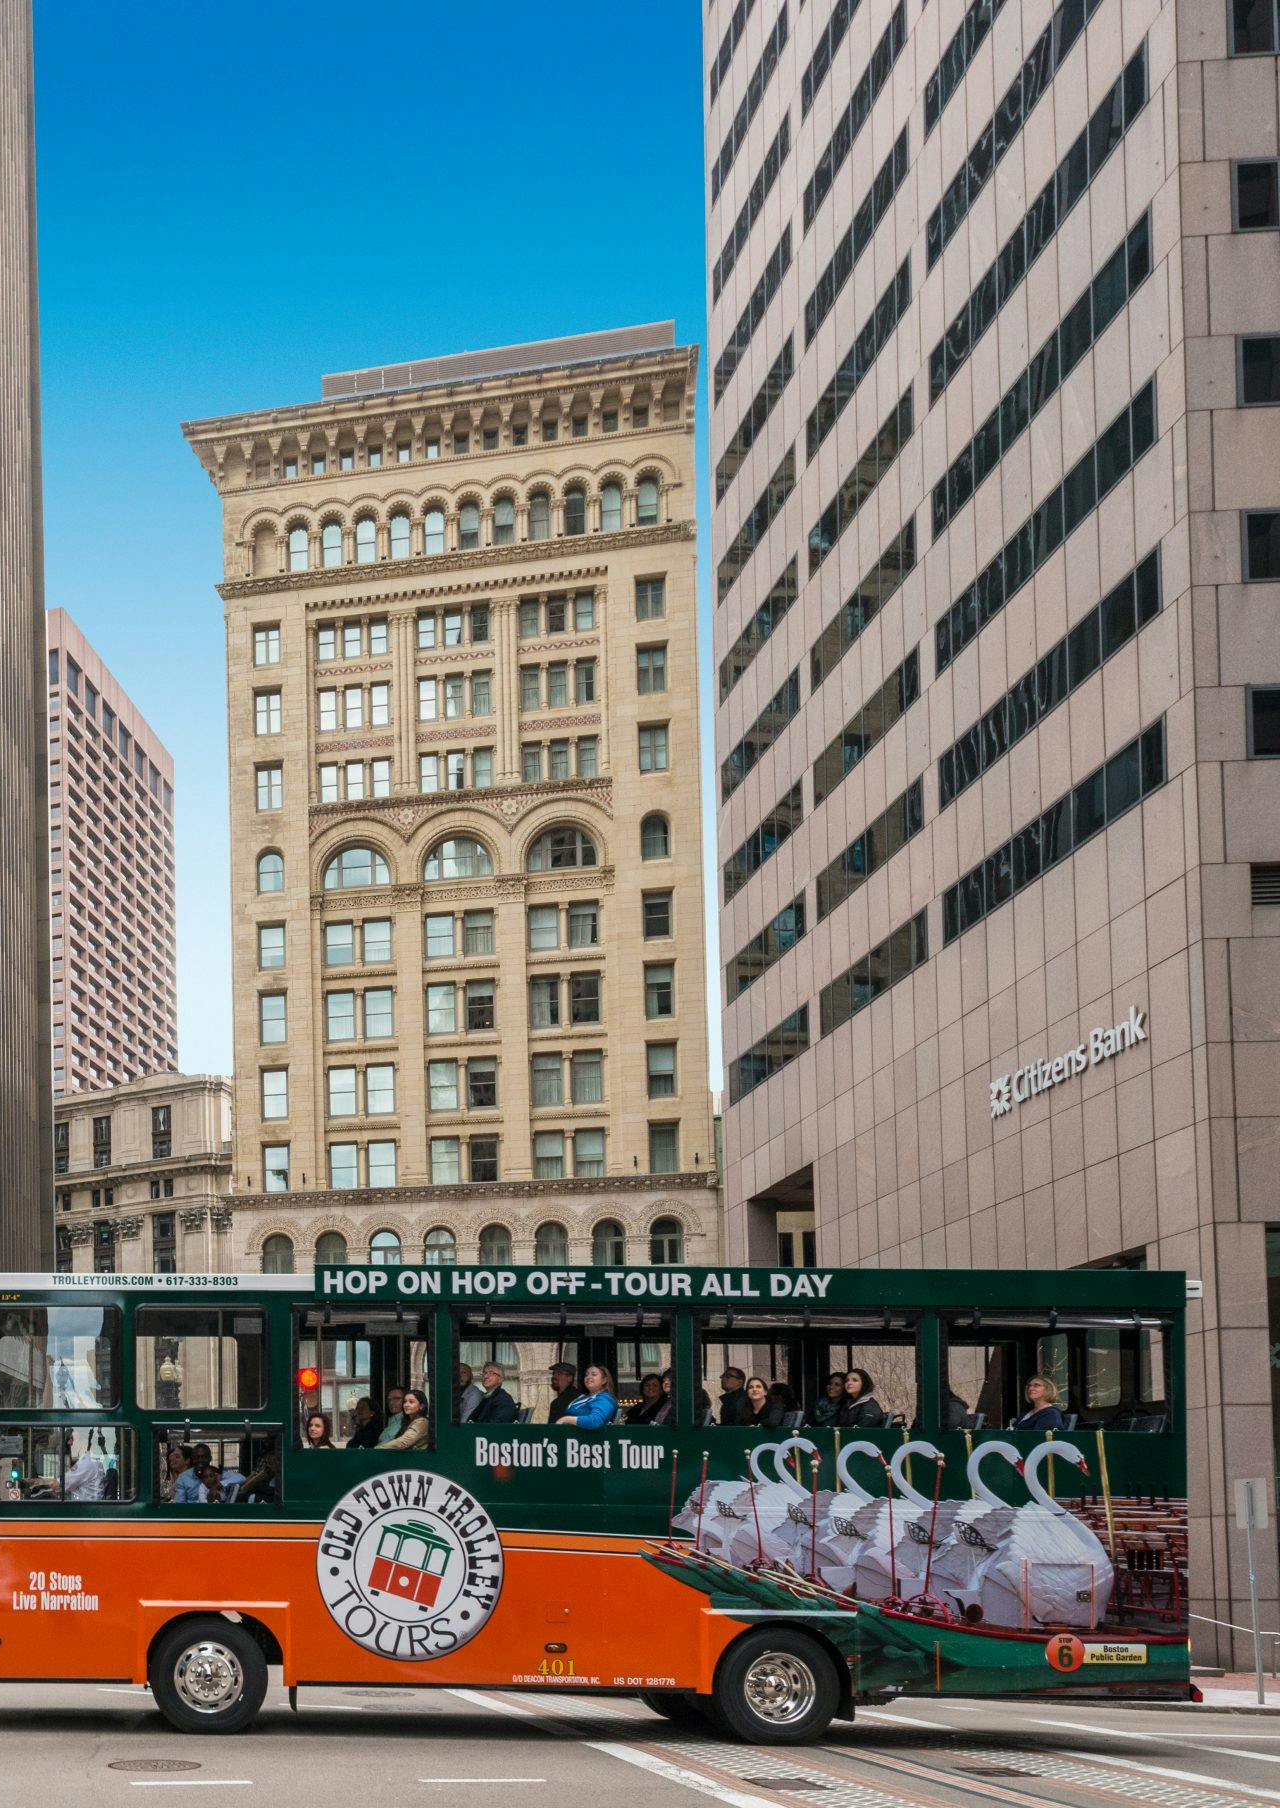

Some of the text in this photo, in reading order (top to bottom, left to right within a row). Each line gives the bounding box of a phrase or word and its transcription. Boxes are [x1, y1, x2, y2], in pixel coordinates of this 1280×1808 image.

[1011, 1005, 1147, 1103] Citizens Bank
[52, 1275, 239, 1286] TROLLEYTOURS.COM 617-333-8303
[323, 1270, 389, 1295] HOP
[397, 1270, 442, 1295] ON
[451, 1271, 516, 1296] HOP
[701, 1273, 760, 1298] ALL
[769, 1273, 834, 1299] DAY
[475, 1437, 665, 1470] Boston's Best Tour
[320, 1473, 500, 1612] OLD TOWN TROLLEY
[29, 1571, 82, 1594] 20 Stops
[12, 1590, 99, 1611] Live Narration
[329, 1578, 459, 1657] TOURS
[1058, 1645, 1073, 1667] 6
[1090, 1653, 1143, 1662] Public Garden
[1103, 1645, 1129, 1653] Boston
[538, 1659, 576, 1676] 401
[523, 1674, 545, 1684] DEACON
[613, 1677, 676, 1686] US DOT 1281776
